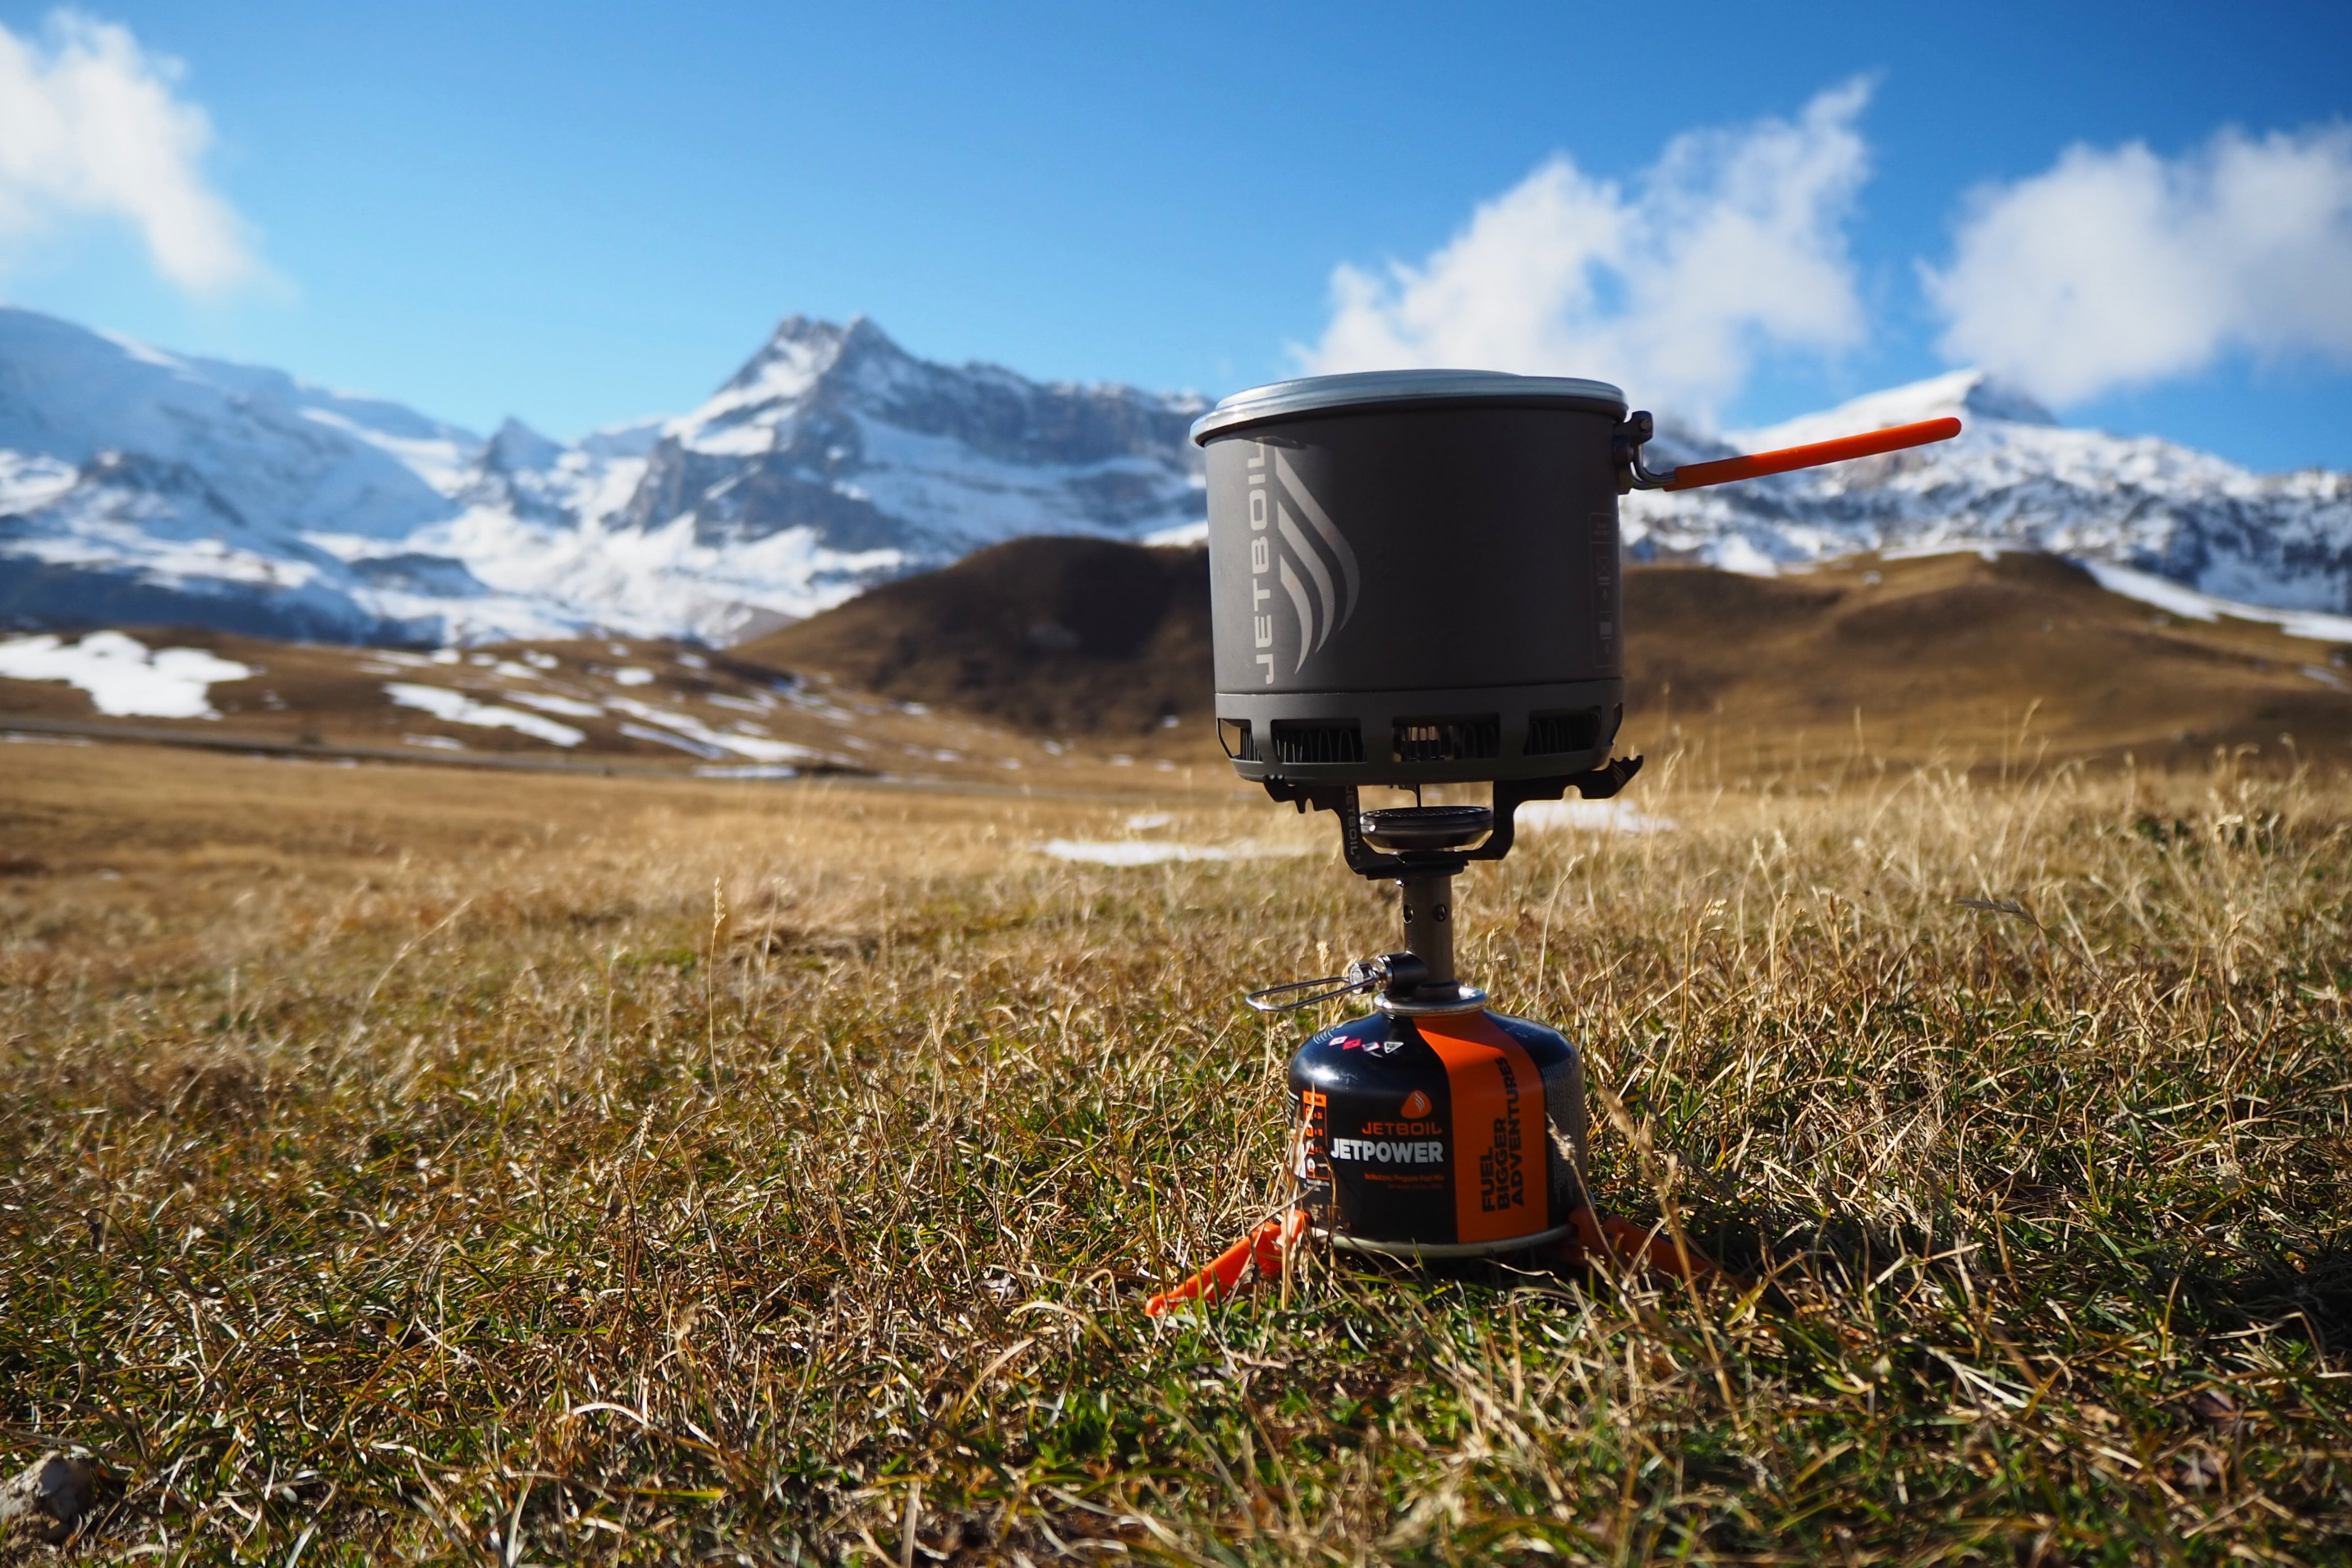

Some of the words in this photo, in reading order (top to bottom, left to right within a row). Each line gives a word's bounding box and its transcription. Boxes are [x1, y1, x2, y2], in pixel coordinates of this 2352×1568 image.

[1247, 437, 1274, 685] JETBOIL
[1345, 787, 1358, 855] JETBOIL
[1330, 1138, 1444, 1163] JETPOWER
[1362, 1122, 1442, 1136] JETBOIL
[1496, 1058, 1523, 1206] ADVENTURES
[1480, 1148, 1495, 1212] FUEL
[1494, 1118, 1510, 1210] BIGGER
